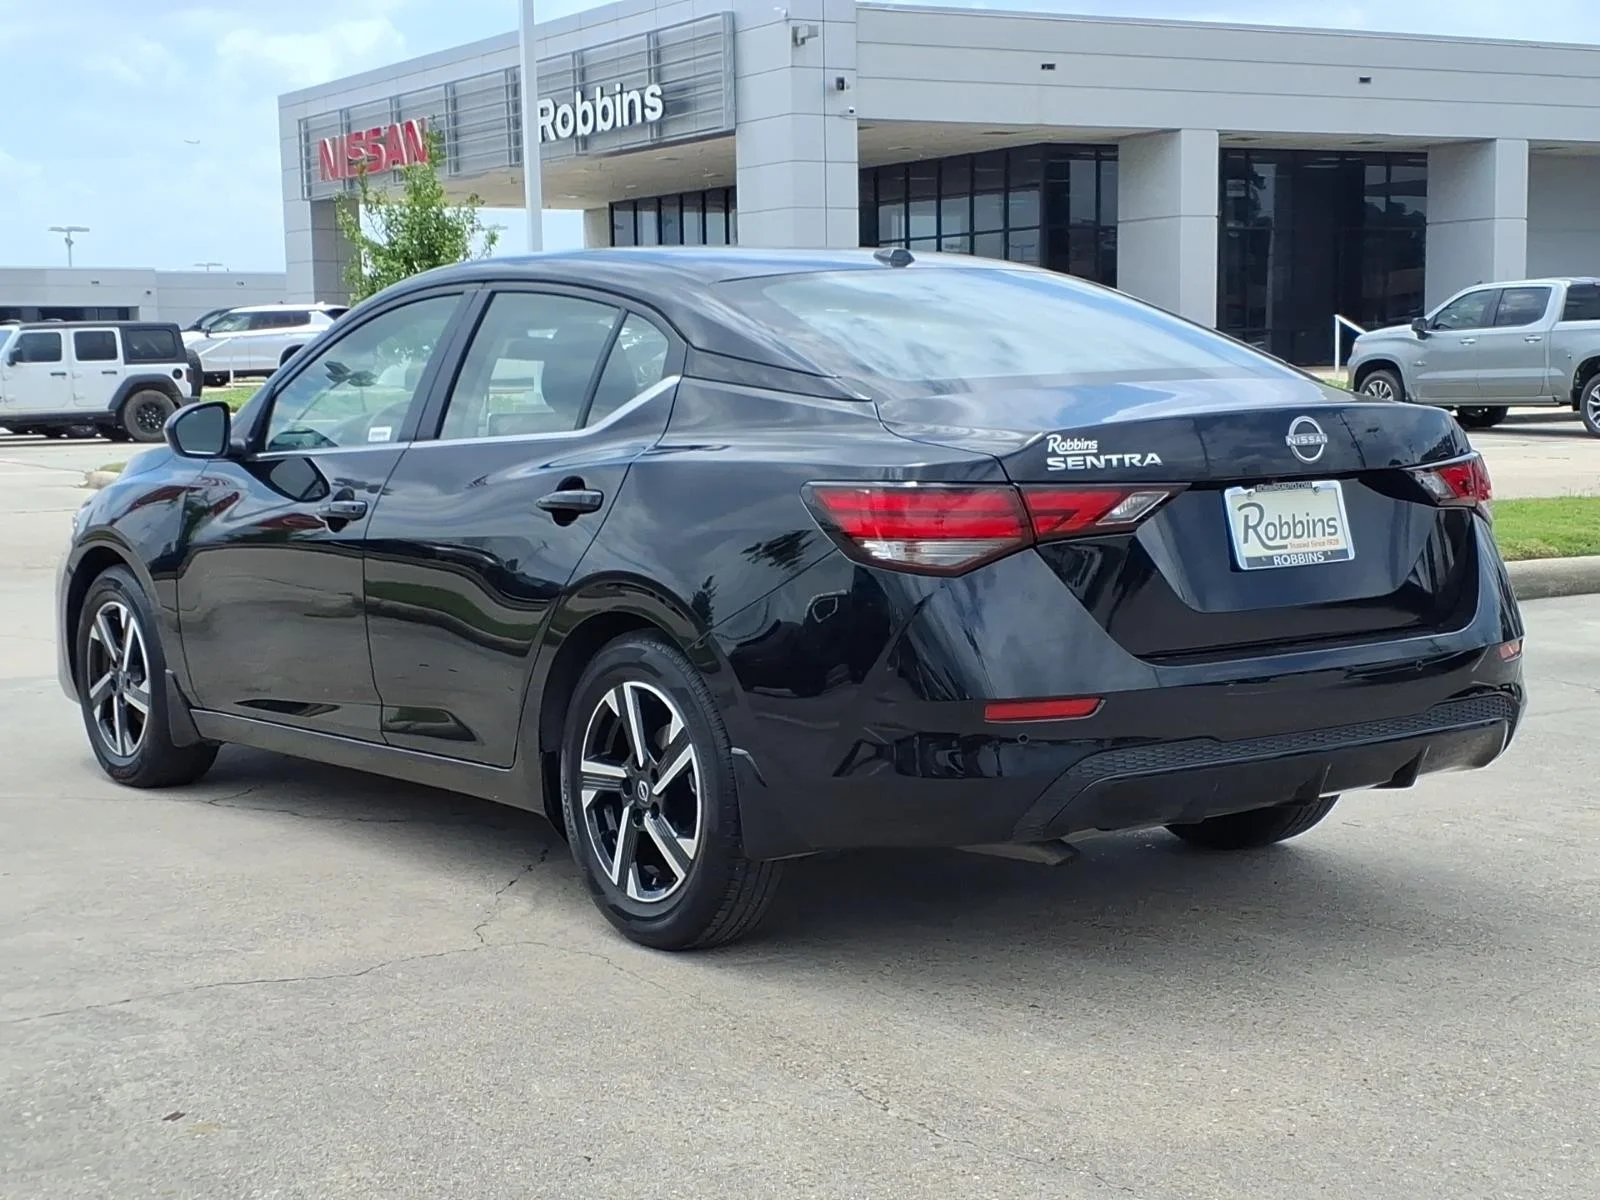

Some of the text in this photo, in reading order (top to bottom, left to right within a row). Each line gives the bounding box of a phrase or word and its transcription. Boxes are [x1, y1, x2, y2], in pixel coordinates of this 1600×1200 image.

[537, 83, 663, 143] Robbins
[319, 117, 428, 182] NISSAN
[1046, 434, 1098, 454] Robbins
[1285, 433, 1328, 446] NISSAN
[1046, 453, 1163, 471] SENTRA
[1237, 502, 1338, 551] Robbins
[1273, 551, 1325, 566] ROBBINS
